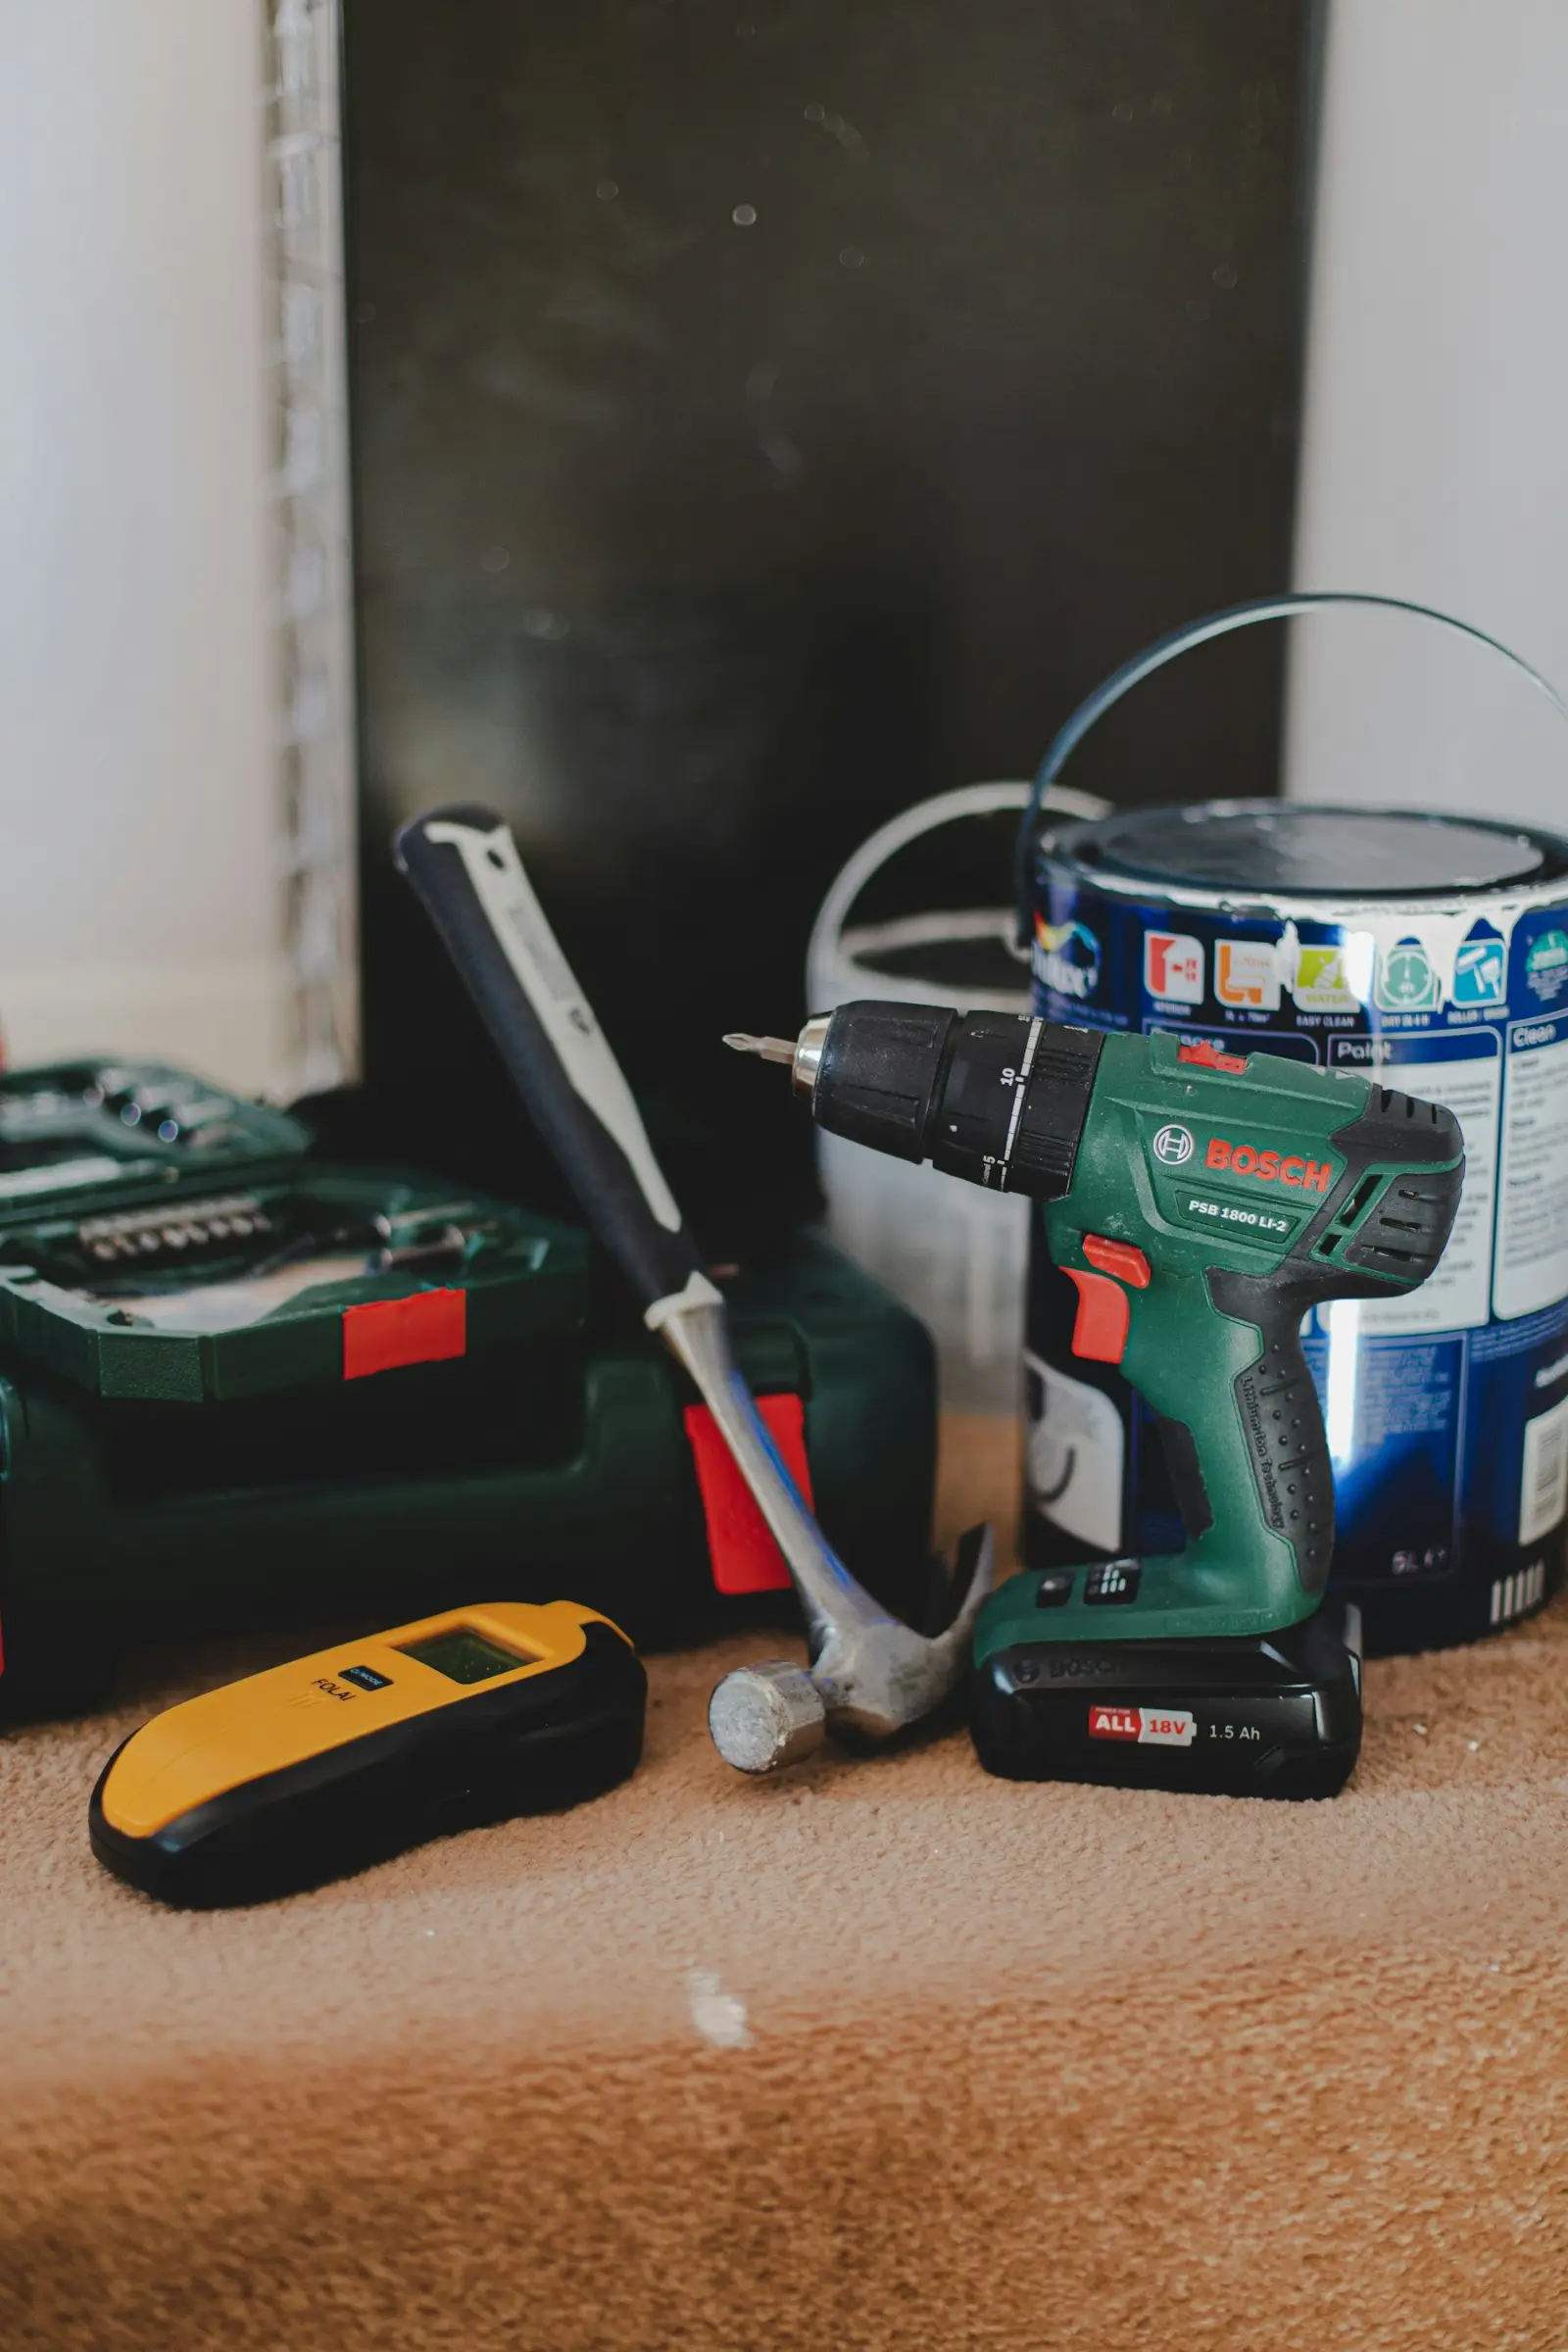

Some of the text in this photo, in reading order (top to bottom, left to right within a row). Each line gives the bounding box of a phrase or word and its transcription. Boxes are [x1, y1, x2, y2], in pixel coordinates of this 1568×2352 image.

[1297, 1015, 1355, 1027] EASY CLEAN
[1513, 1023, 1556, 1048] Clean
[1338, 1041, 1394, 1060] Paint
[1001, 1067, 1016, 1087] 10
[983, 1154, 996, 1164] 5
[1204, 1138, 1333, 1193] BOSCH
[1189, 1200, 1290, 1233] PSB 1800 LI-2
[312, 1679, 357, 1700] FOLAI
[1095, 1714, 1186, 1735] ALL 18V
[1209, 1725, 1261, 1741] 1.5 Ah
